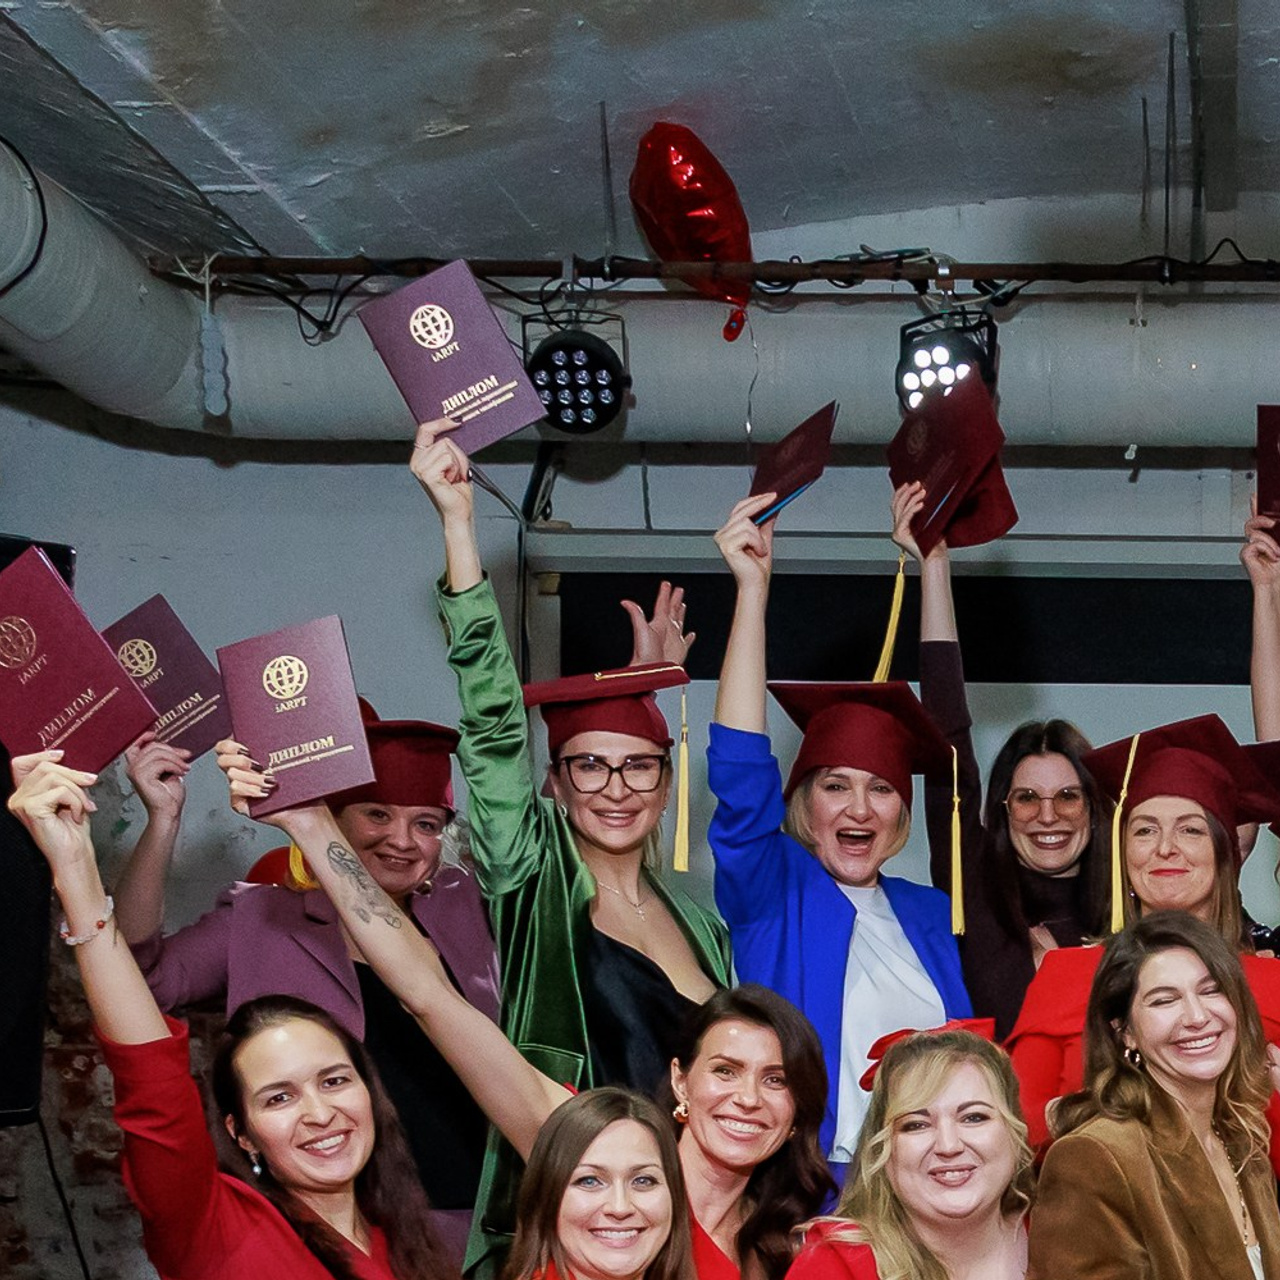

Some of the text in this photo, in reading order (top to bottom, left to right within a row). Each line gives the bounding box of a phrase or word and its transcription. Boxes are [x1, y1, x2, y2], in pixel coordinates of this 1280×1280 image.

[431, 341, 460, 363] iARPT
[441, 374, 499, 414] ДИПЛОМ
[18, 654, 48, 685] iARPT
[140, 667, 164, 689] iARPT
[37, 687, 97, 746] ДИПЛОМ
[275, 695, 308, 713] iARPT
[268, 735, 334, 766] ДИПЛОМ
